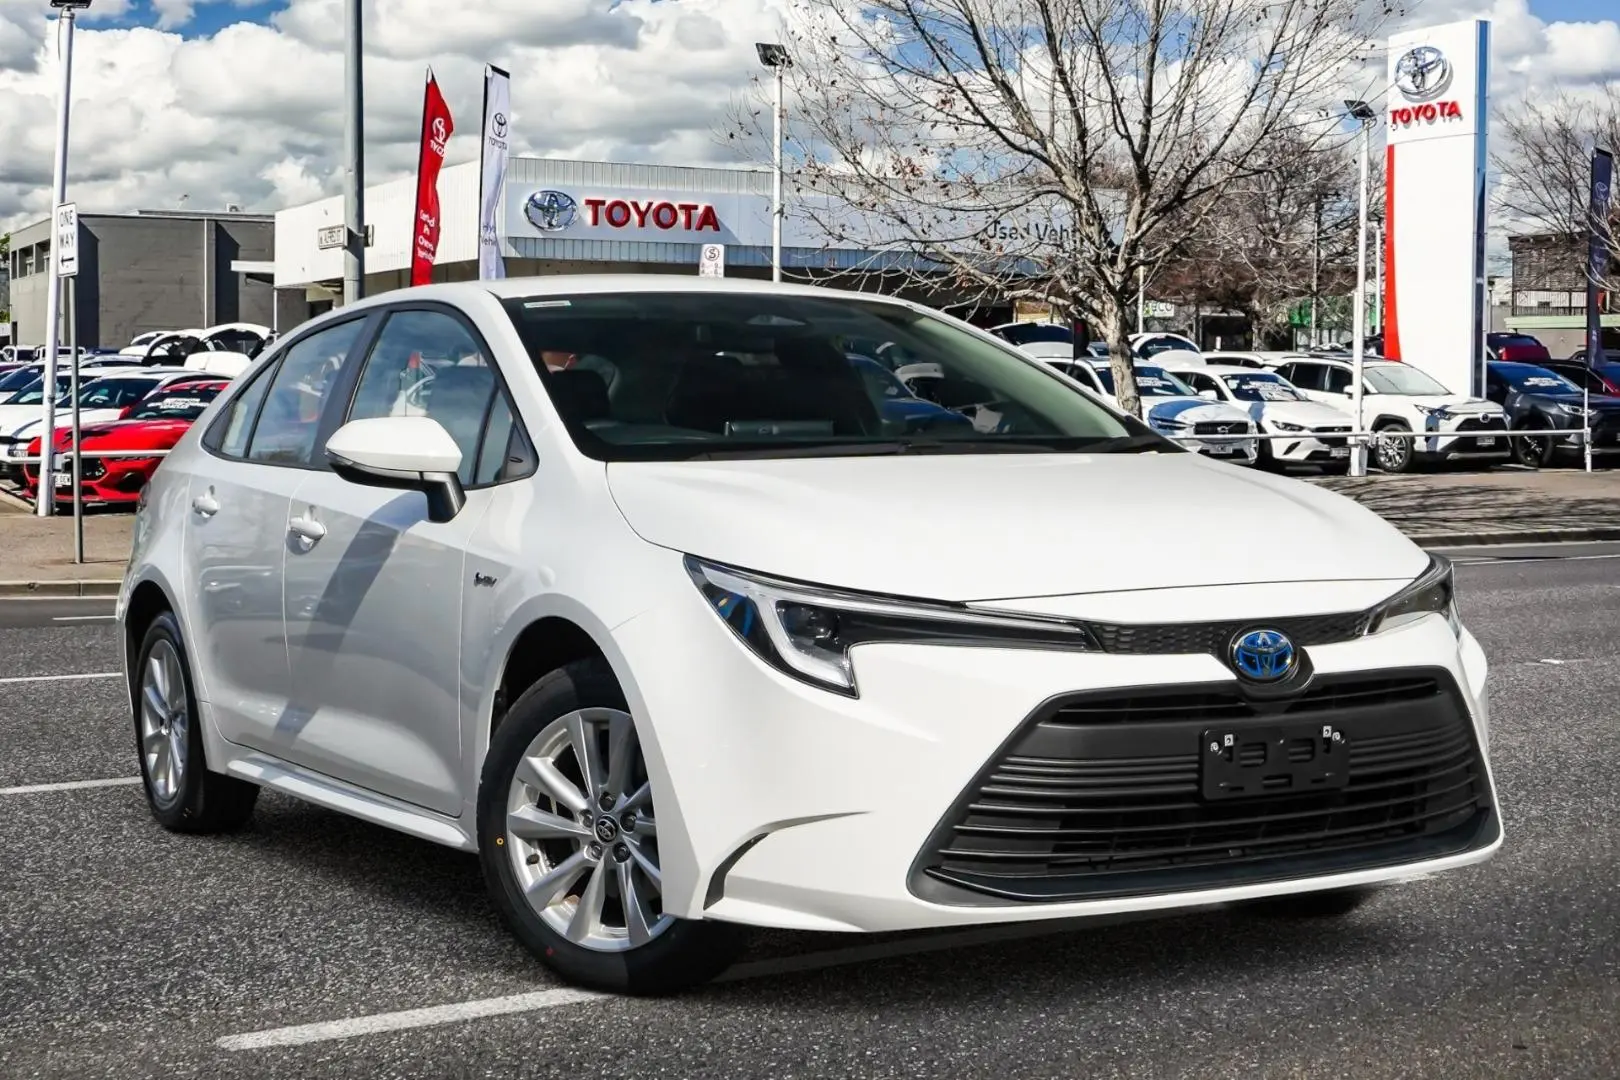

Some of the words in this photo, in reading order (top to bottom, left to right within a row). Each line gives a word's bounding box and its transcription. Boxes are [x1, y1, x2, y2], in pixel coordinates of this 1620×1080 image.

[1390, 101, 1461, 124] TOYOTA
[59, 210, 73, 227] ONE
[585, 199, 720, 231] TOYOTA
[59, 232, 74, 248] WAY
[985, 220, 1030, 240] Used
